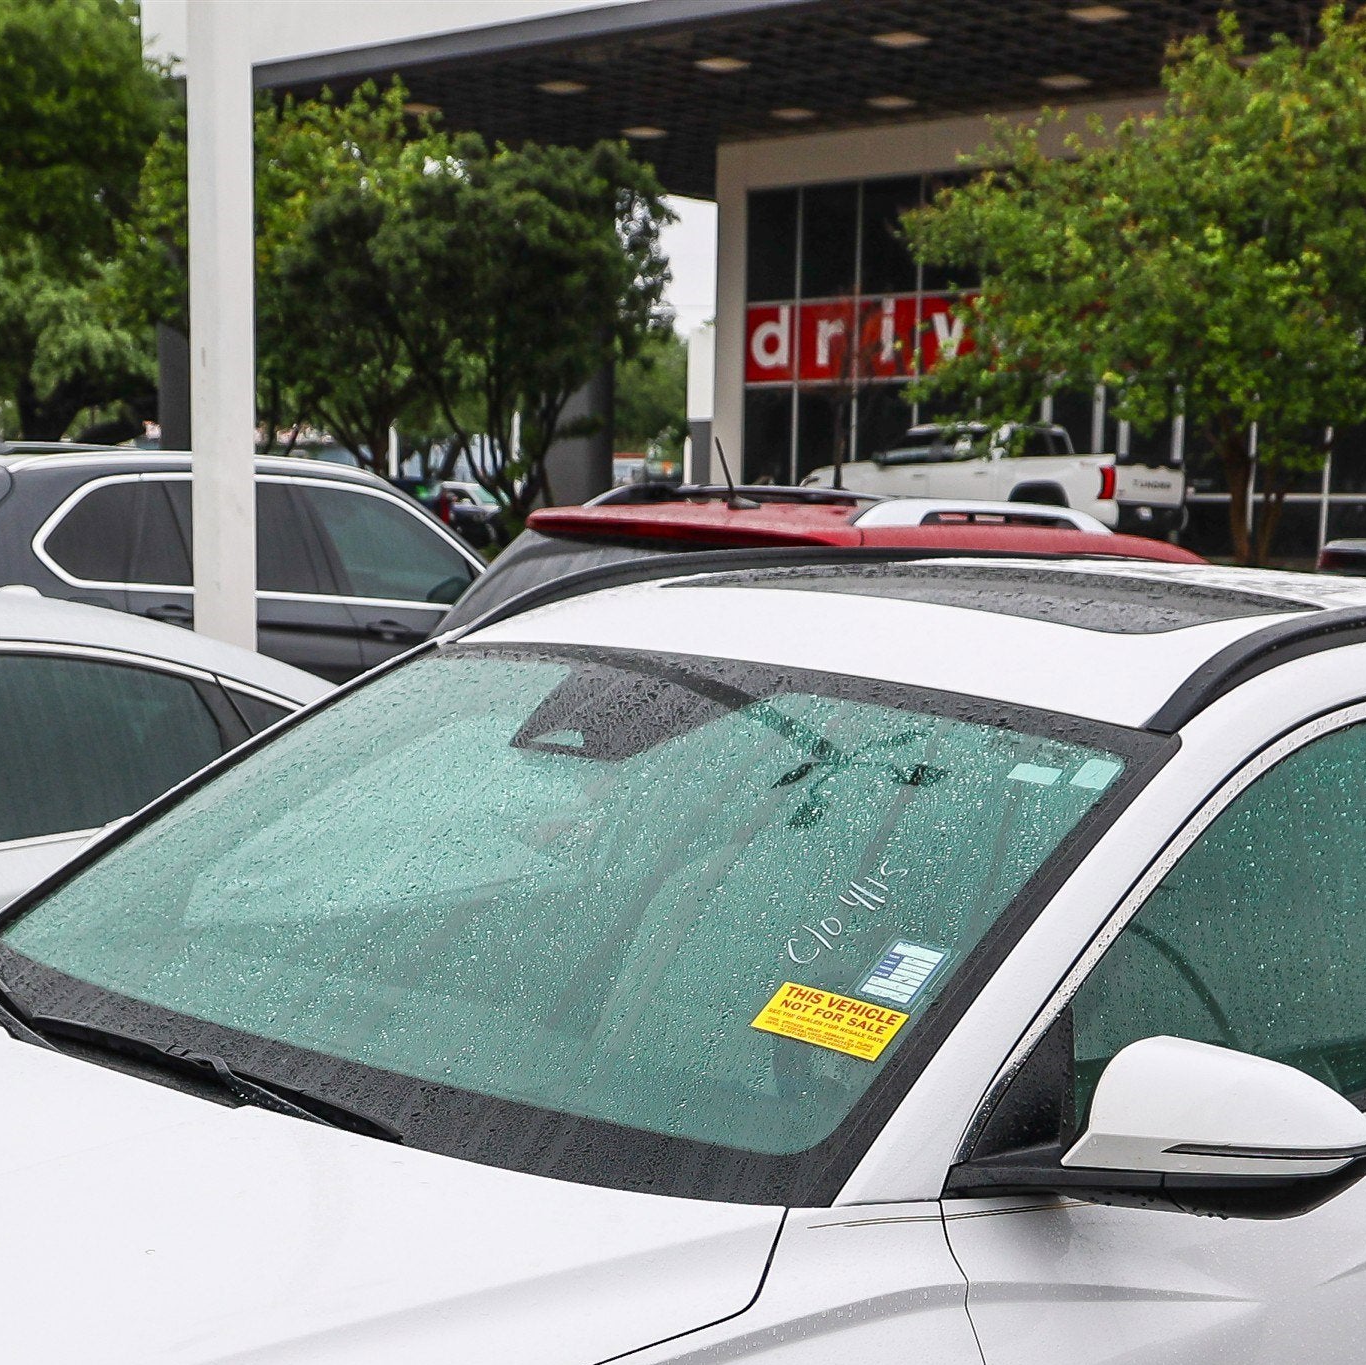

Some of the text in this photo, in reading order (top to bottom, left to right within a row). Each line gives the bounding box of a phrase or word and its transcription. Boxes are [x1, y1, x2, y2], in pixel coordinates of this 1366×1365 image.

[751, 299, 967, 371] driv
[780, 999, 888, 1035] NOT FOR SALE
[785, 986, 825, 1005] THIS
[827, 997, 901, 1026] VEHICLE
[866, 1034, 886, 1044] DATE
